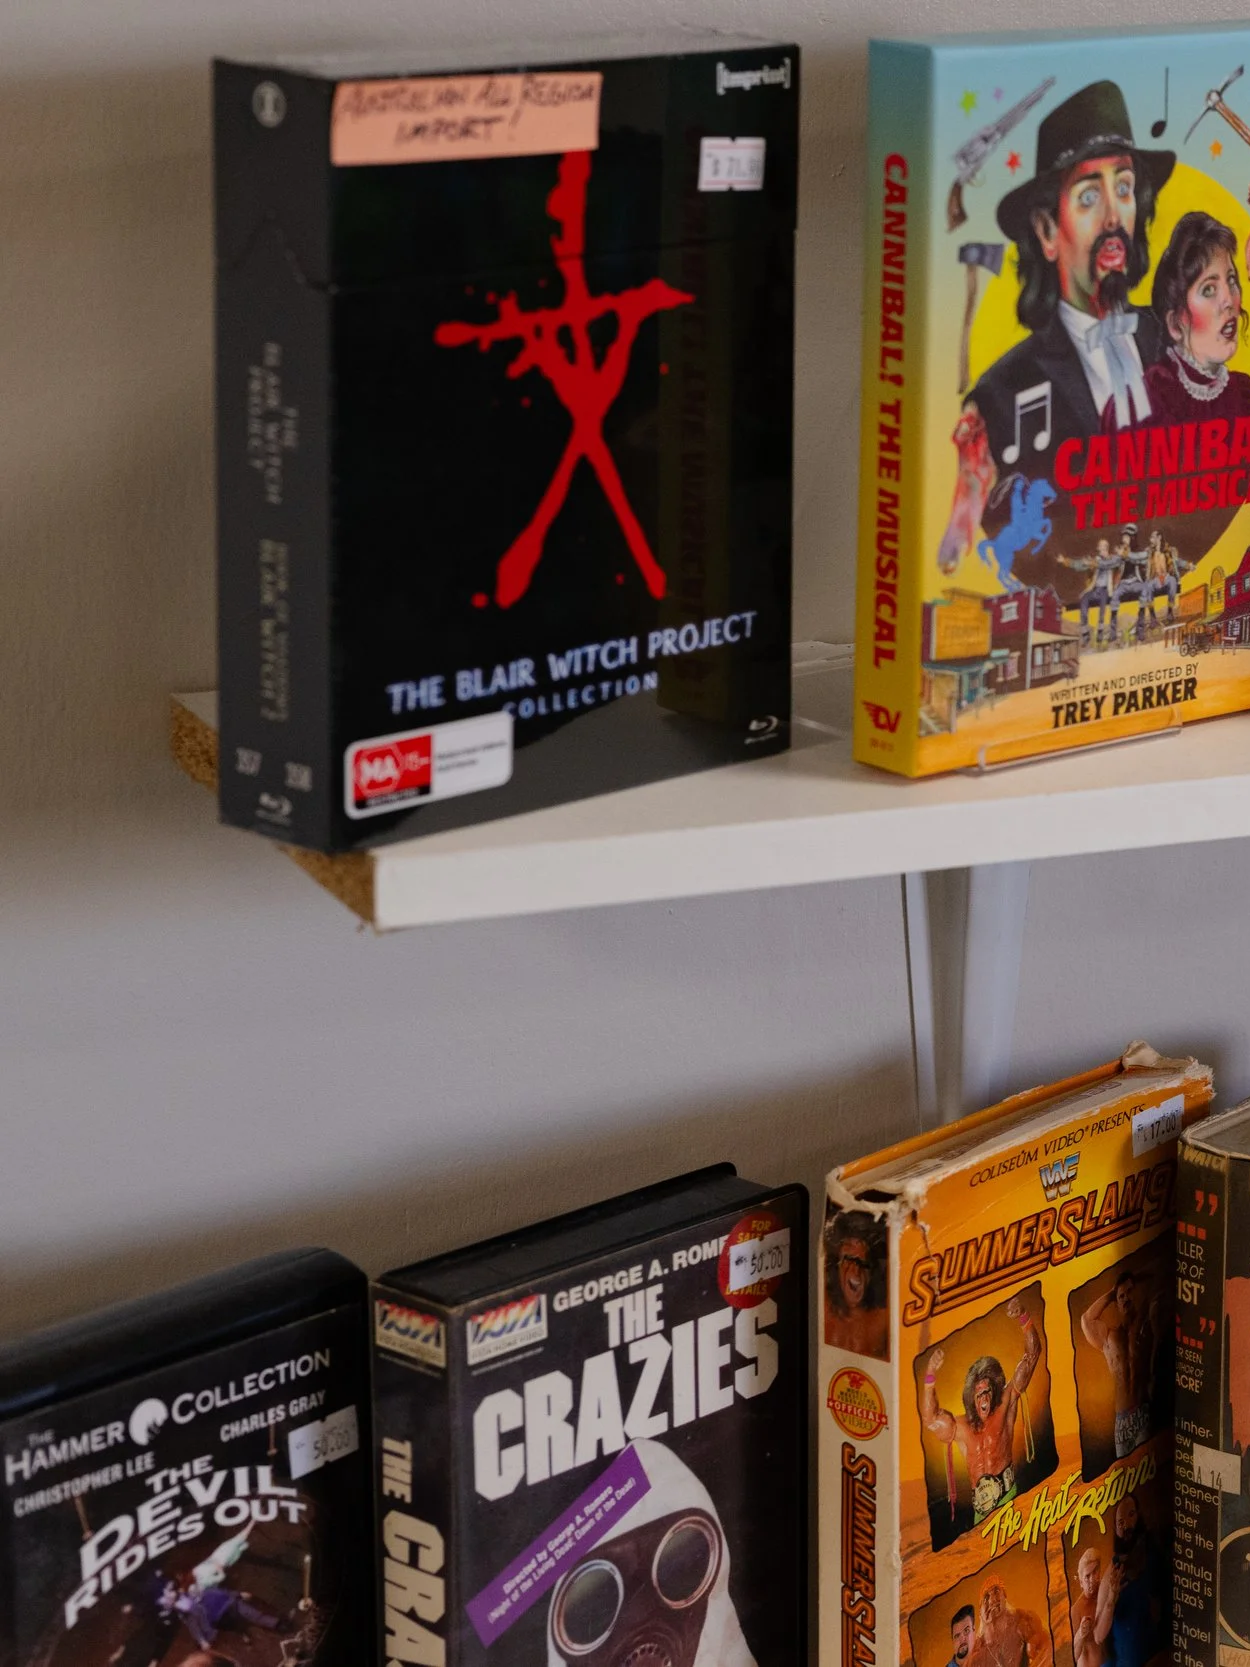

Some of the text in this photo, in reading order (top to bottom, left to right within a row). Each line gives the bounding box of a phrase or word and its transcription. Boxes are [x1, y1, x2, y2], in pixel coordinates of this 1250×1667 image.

[872, 153, 909, 671] CANNIBAL! THE MUSICAL
[1069, 488, 1141, 531] THE
[386, 611, 758, 715] THE BLAIR WITCH PROJECT
[1050, 662, 1199, 702] WRITTEN AND DIRECTED BY
[502, 671, 659, 720] COLLECTION
[1051, 677, 1198, 729] TREY PARKER
[1150, 1113, 1177, 1140] 17.00
[969, 1128, 1085, 1189] COLISEUM VIDEO
[751, 1220, 772, 1232] FOR
[903, 1168, 1145, 1328] SUMMERSLAM
[552, 1252, 671, 1314] GEORGE A.
[602, 1283, 664, 1348] THE
[5, 1421, 125, 1485] HAMMER
[171, 1347, 332, 1425] COLLECTION
[219, 1390, 326, 1443] CHARLES GRAY
[472, 1296, 779, 1502] CRAZIES
[834, 1401, 880, 1423] OFFICIAL
[28, 1428, 54, 1446] THE
[1180, 1416, 1214, 1438] inher-
[13, 1450, 158, 1518] CHRISTOPHER LEE
[145, 1453, 214, 1493] THE
[382, 1437, 413, 1503] THE
[80, 1464, 298, 1583] DEVIL
[981, 1453, 1157, 1559] The Heat Returns
[1185, 1499, 1201, 1514] his
[63, 1499, 308, 1631] RIDES OUT
[841, 1442, 877, 1667] SUMMERSLA
[1185, 1547, 1194, 1559] a
[1195, 1532, 1214, 1551] the
[1204, 1583, 1213, 1597] is
[1182, 1621, 1211, 1644] hotel
